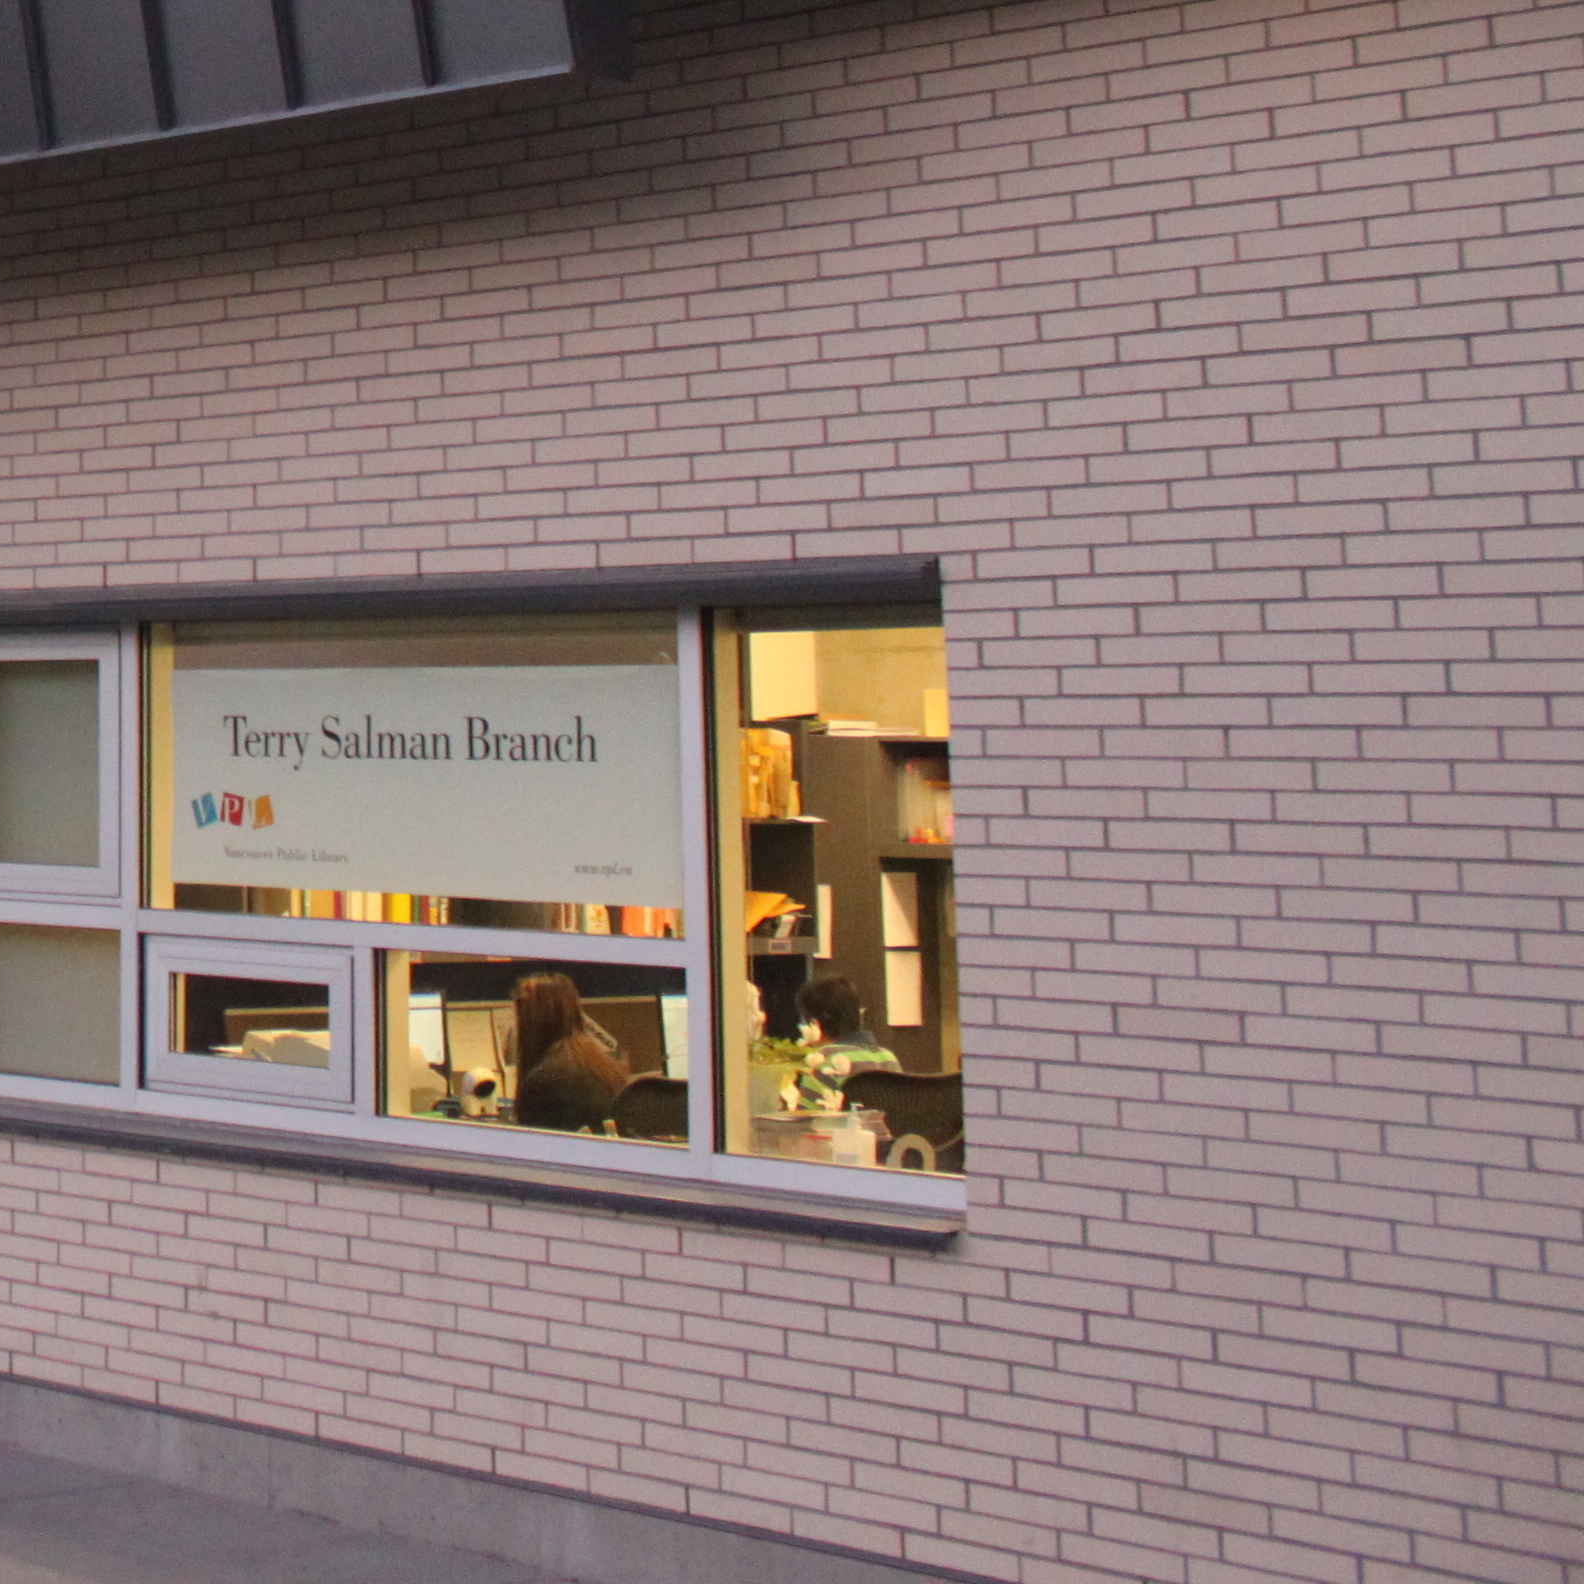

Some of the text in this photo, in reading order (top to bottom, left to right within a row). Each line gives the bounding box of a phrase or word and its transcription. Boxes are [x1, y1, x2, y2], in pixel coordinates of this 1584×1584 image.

[223, 713, 599, 771] Terry Salman Branch
